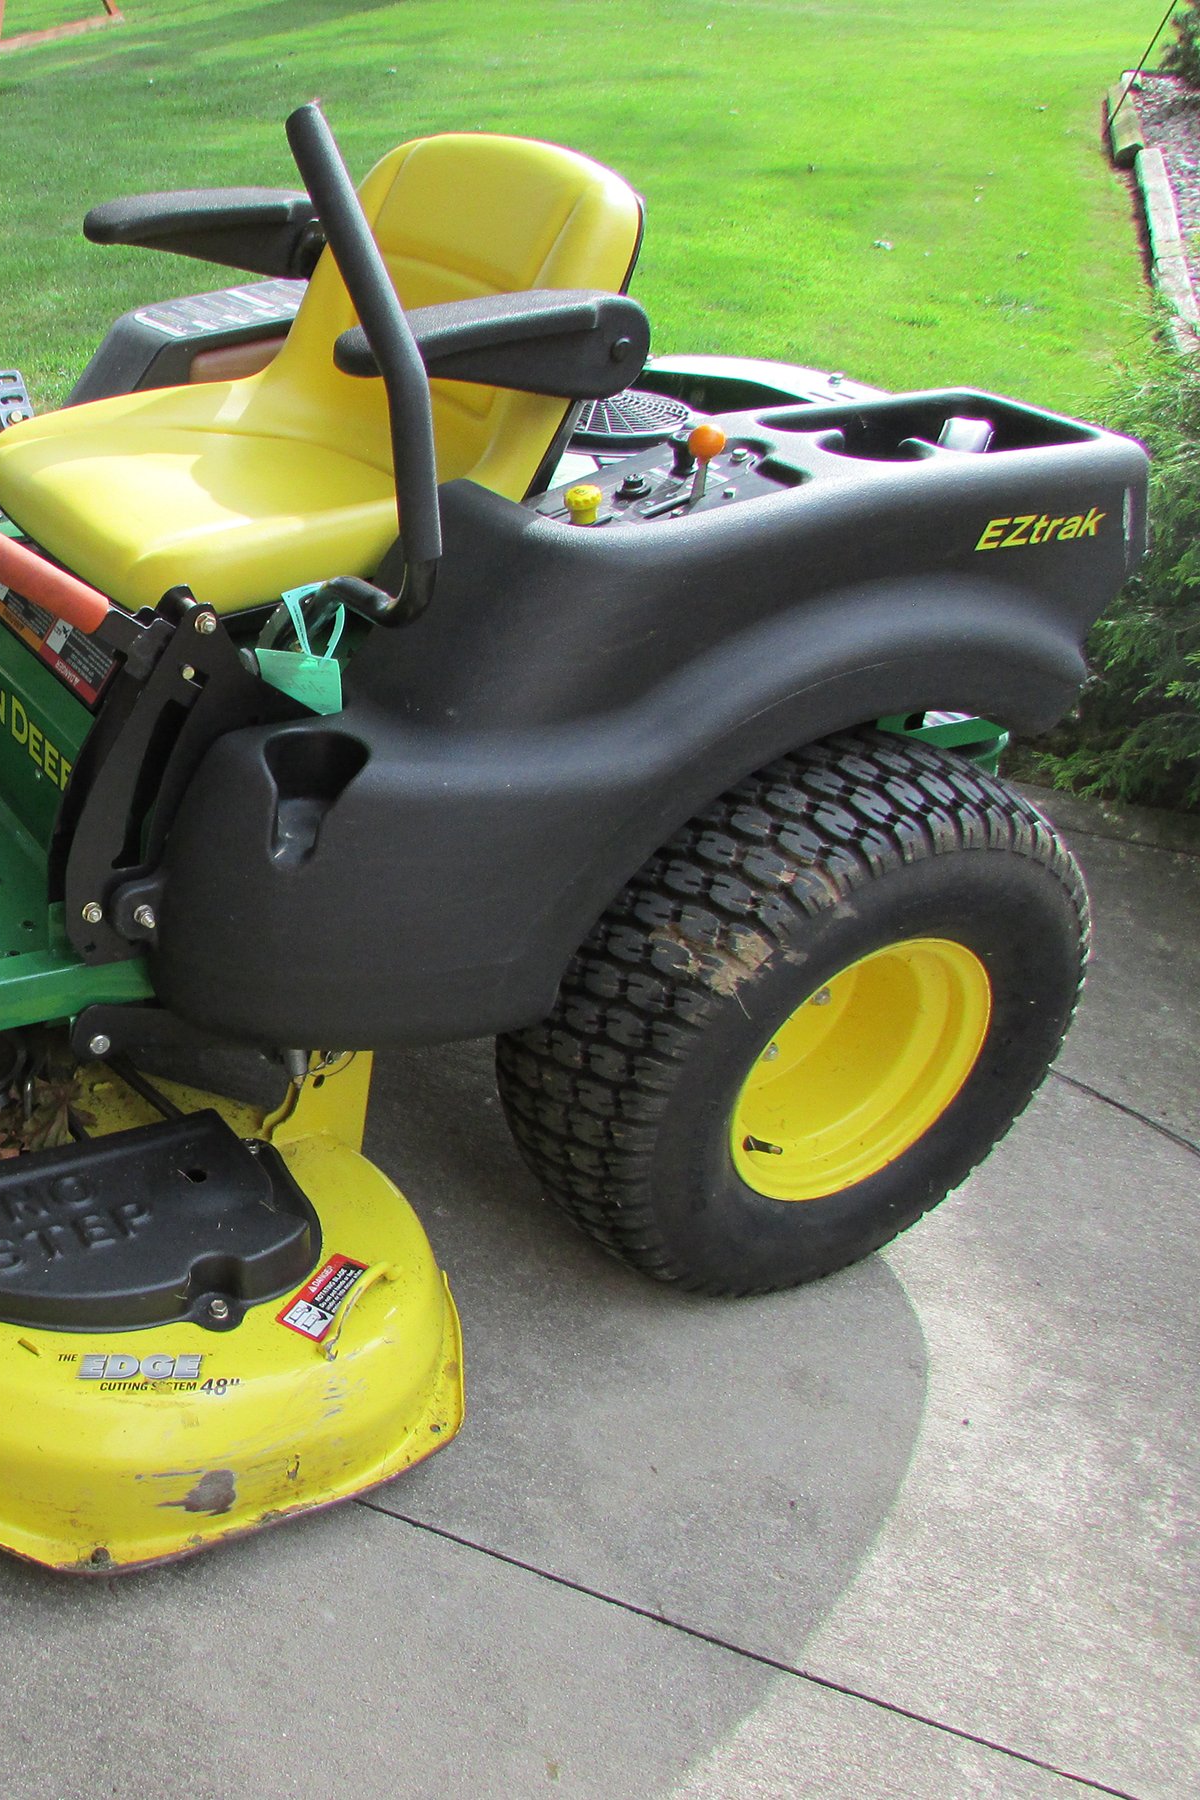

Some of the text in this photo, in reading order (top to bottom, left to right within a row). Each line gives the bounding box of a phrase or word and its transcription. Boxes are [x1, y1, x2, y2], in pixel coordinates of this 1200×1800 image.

[974, 507, 1107, 551] EZtrak
[312, 1265, 335, 1288] DANGER
[57, 1353, 203, 1379] THE EDGE
[100, 1381, 148, 1391] CUTTING
[200, 1378, 240, 1396] 48"
